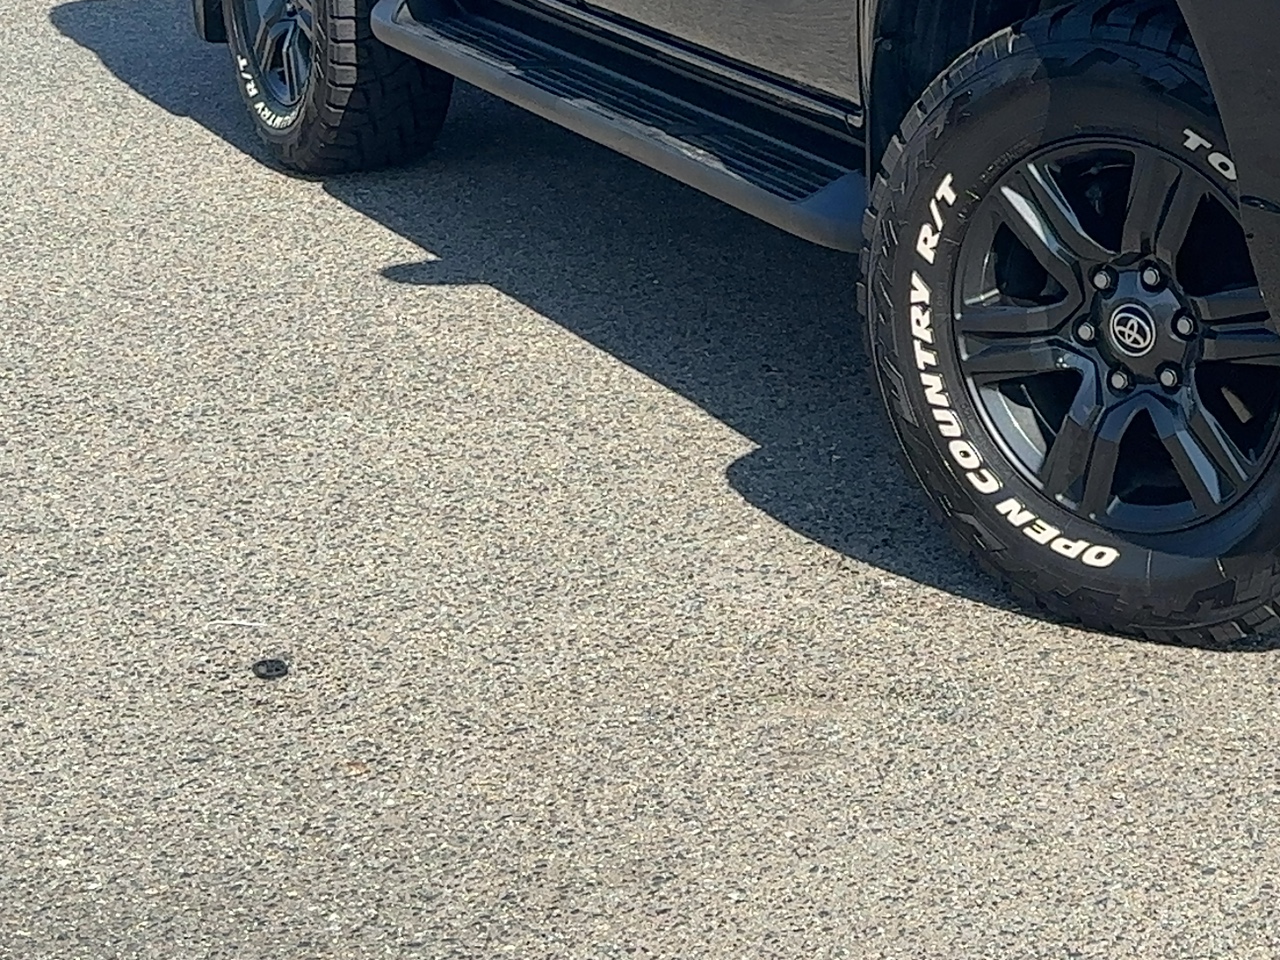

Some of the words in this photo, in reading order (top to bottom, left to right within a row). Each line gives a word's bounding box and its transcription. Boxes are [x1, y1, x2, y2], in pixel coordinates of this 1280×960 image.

[1183, 128, 1238, 181] TO
[916, 173, 959, 265] R/T
[910, 270, 1003, 495] COUNTRY
[995, 496, 1121, 568] OPEN
